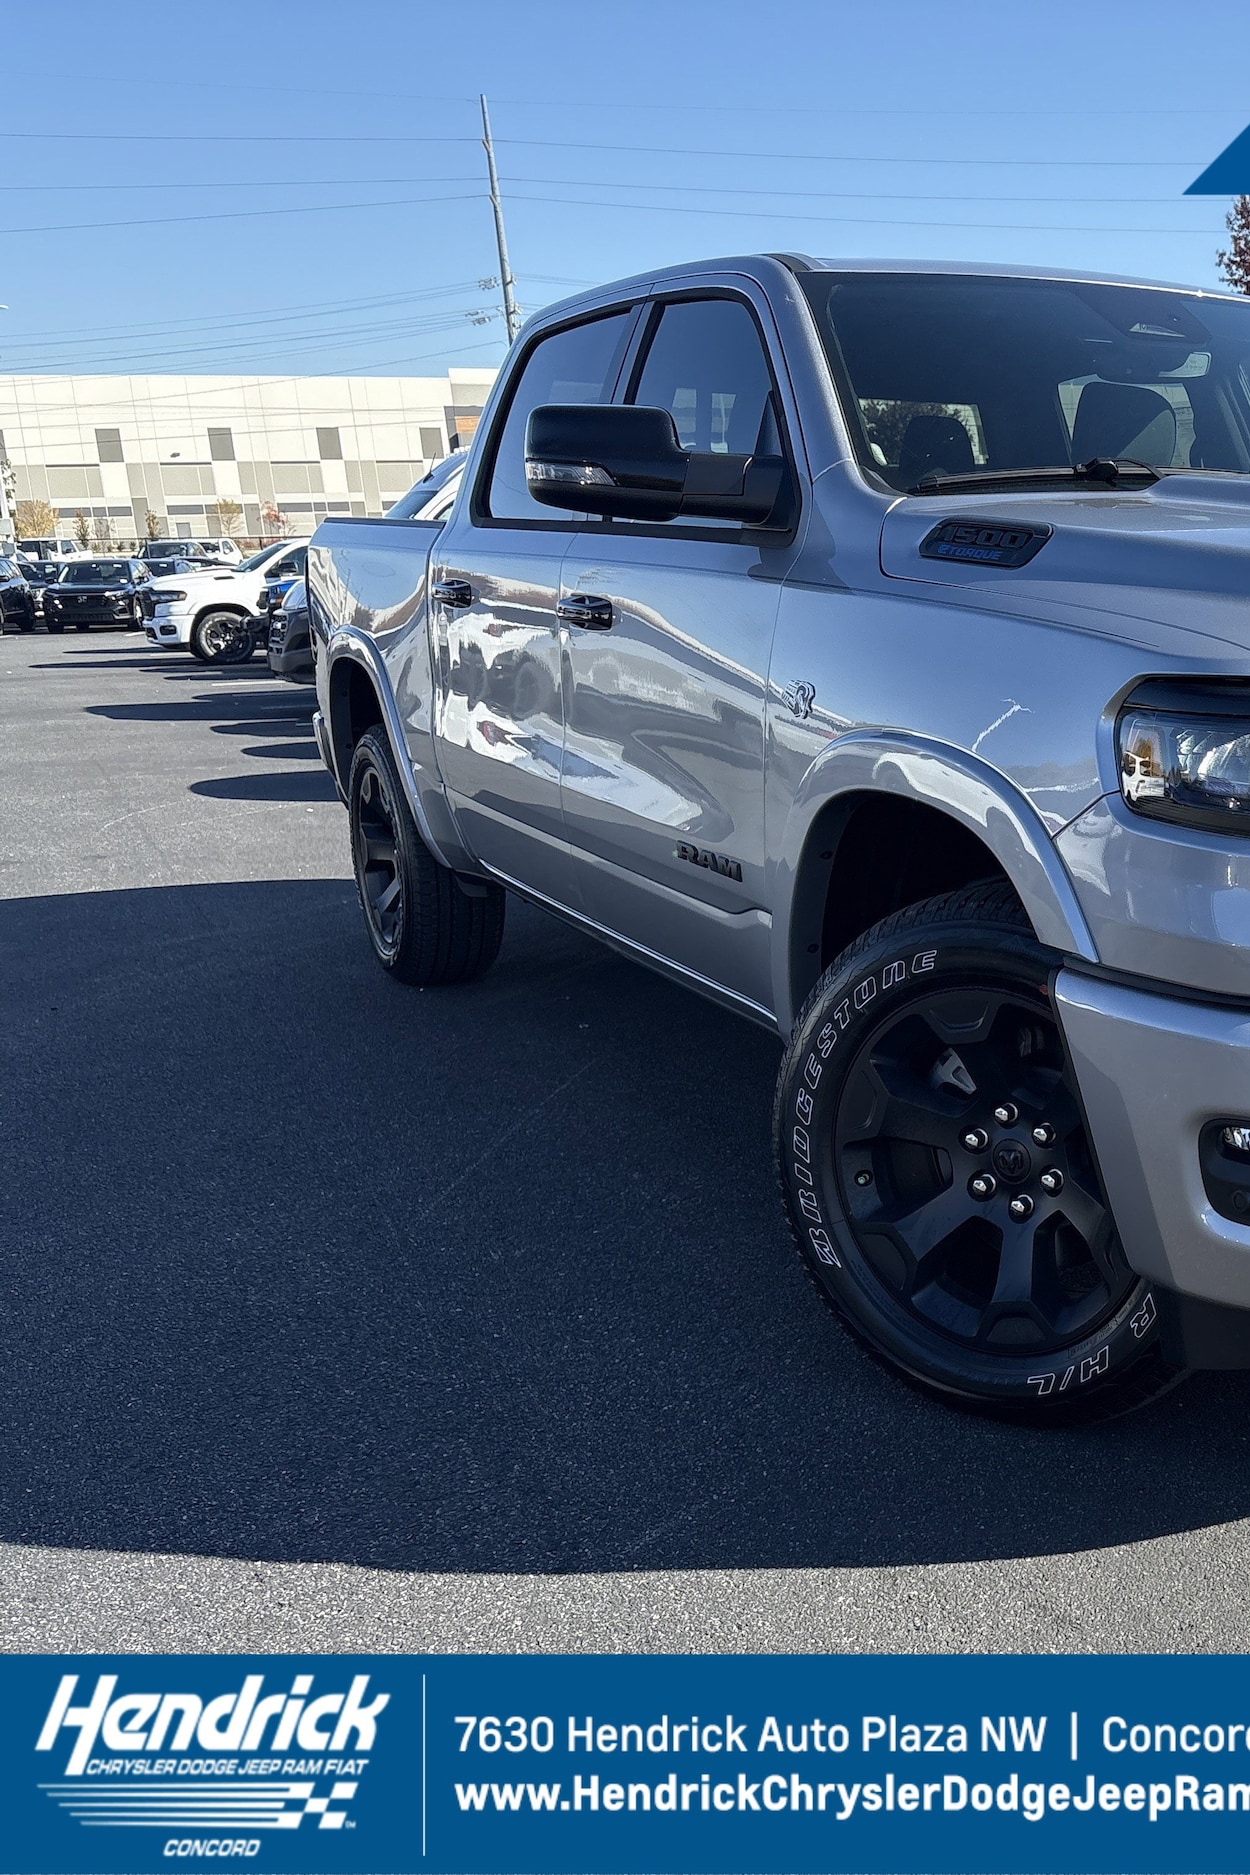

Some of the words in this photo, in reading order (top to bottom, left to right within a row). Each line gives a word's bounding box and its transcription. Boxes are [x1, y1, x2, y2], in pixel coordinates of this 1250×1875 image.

[940, 525, 1028, 548] 1500
[676, 839, 744, 883] RAM
[792, 949, 939, 1269] BRIDGESTONE
[1026, 1344, 1110, 1396] H/L
